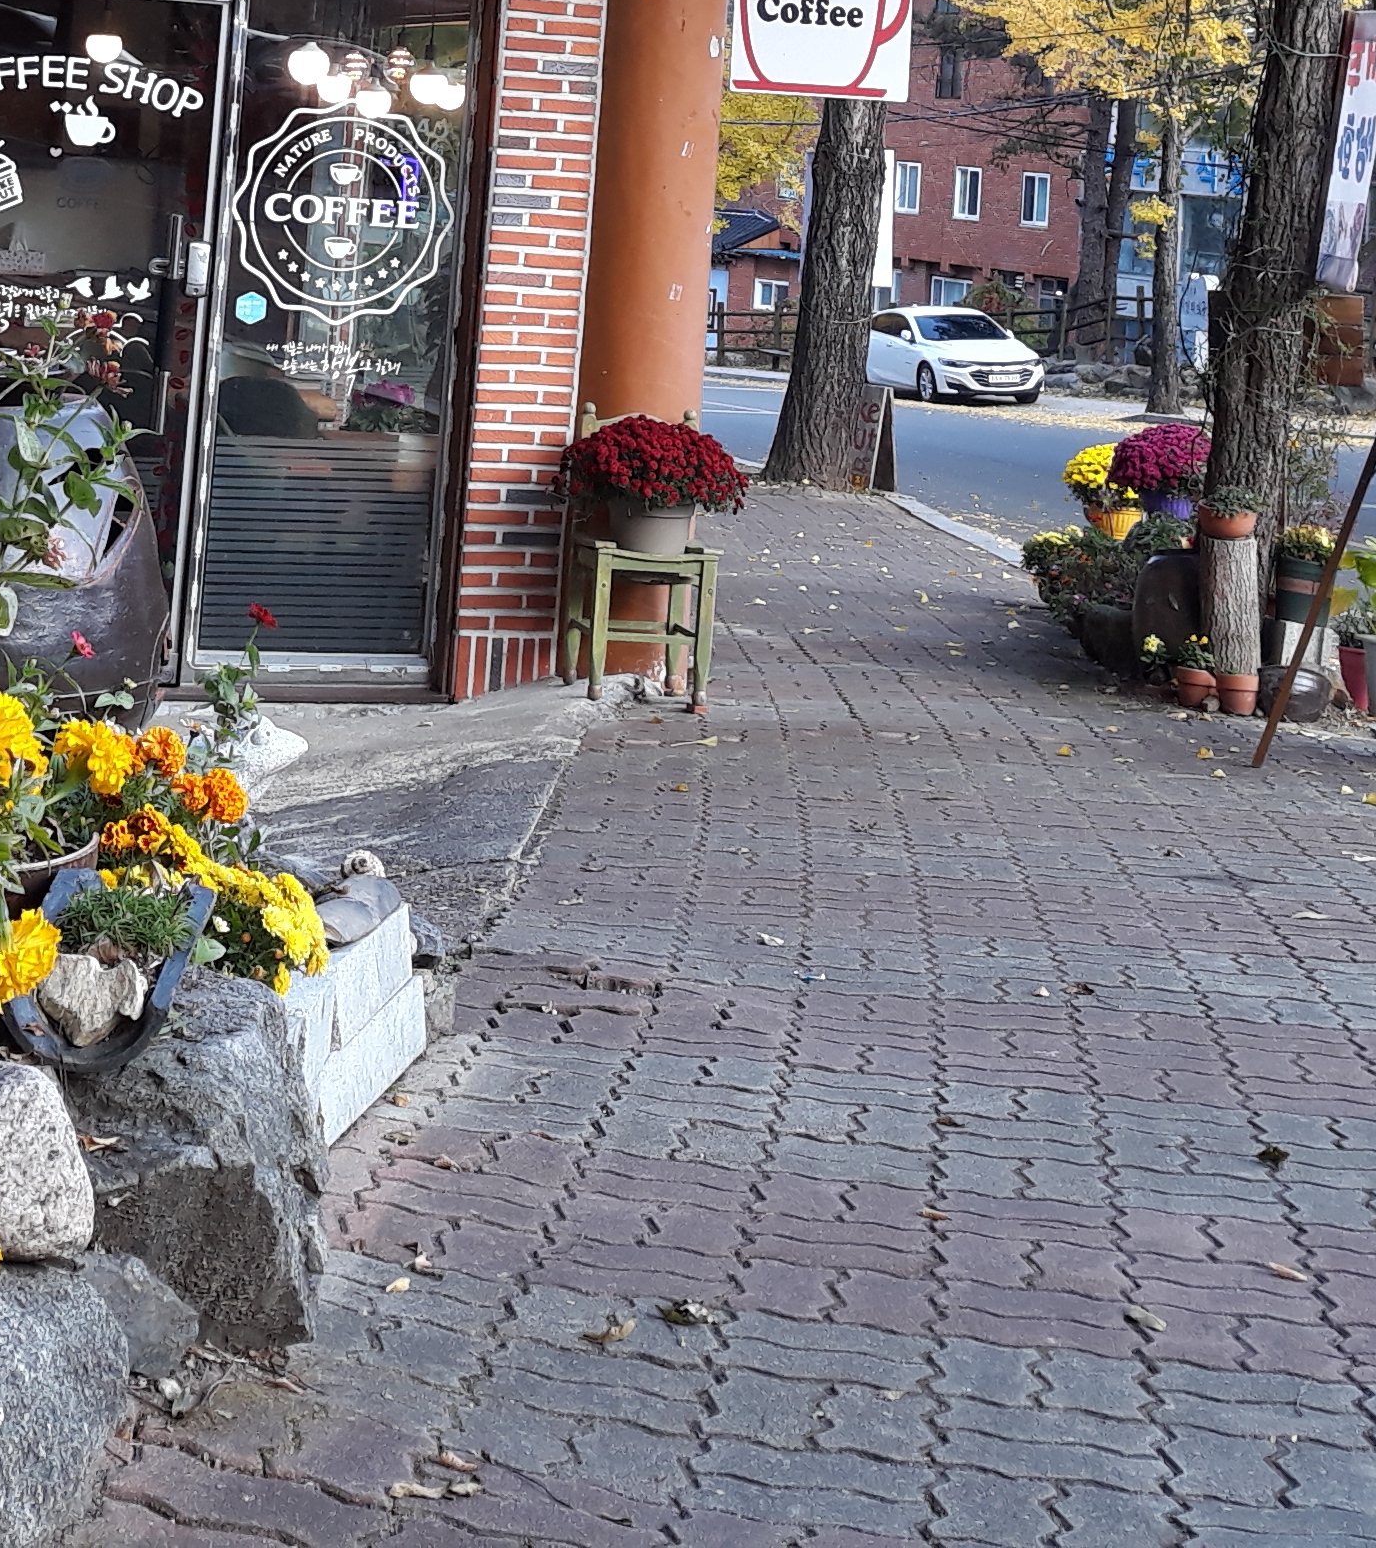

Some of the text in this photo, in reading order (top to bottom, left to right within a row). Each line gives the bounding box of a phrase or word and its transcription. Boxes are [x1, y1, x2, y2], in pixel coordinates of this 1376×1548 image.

[99, 63, 204, 117] SHOP
[274, 128, 421, 198] NATURE PRODUCTS
[264, 192, 420, 230] COFFEE
[266, 342, 279, 352] 내
[281, 341, 304, 357] 기분은
[306, 343, 328, 354] 내가
[282, 357, 299, 375] 오늘
[300, 359, 318, 371] 나는
[375, 358, 401, 375] 할래
